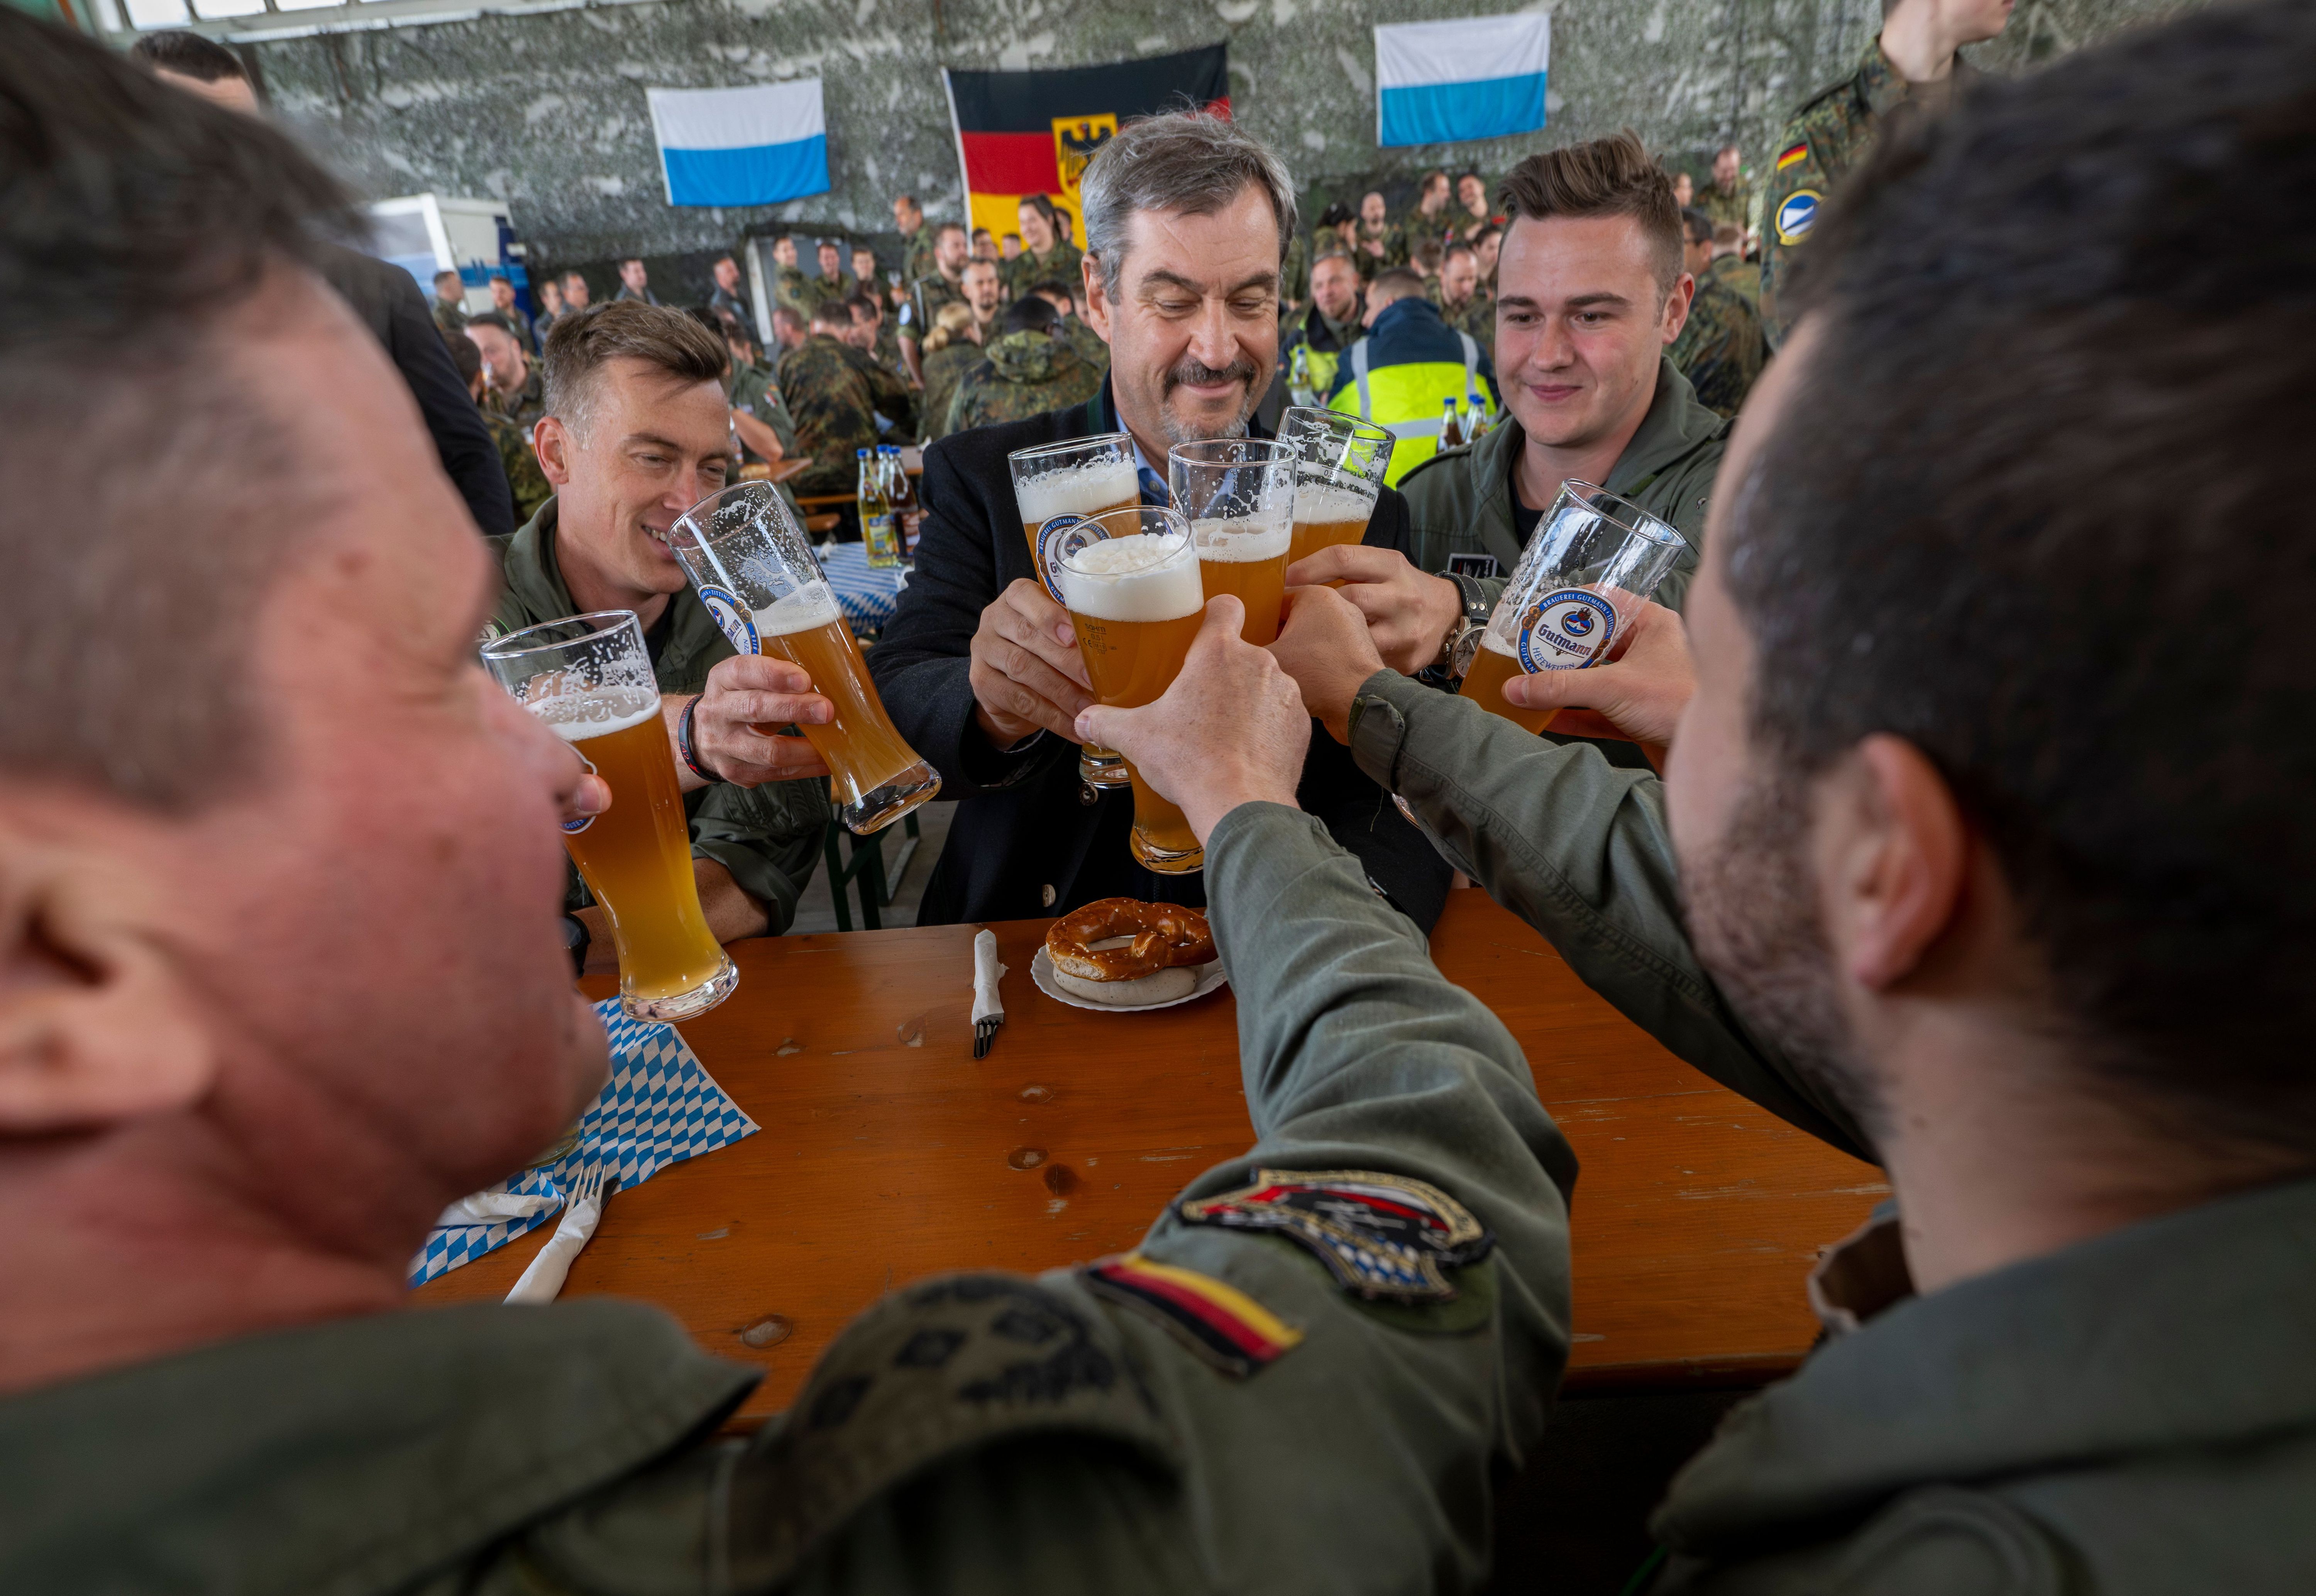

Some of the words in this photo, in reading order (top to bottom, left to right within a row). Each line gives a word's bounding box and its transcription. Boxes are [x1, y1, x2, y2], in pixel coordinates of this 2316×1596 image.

[1039, 526, 1051, 550] BRAUEREI
[711, 590, 731, 602] TITTING
[1543, 594, 1574, 608] BRAUEREI
[1577, 594, 1608, 612] GUTMANN
[1538, 624, 1592, 656] Gutmann
[1532, 647, 1575, 671] HEFEWEIZEN
